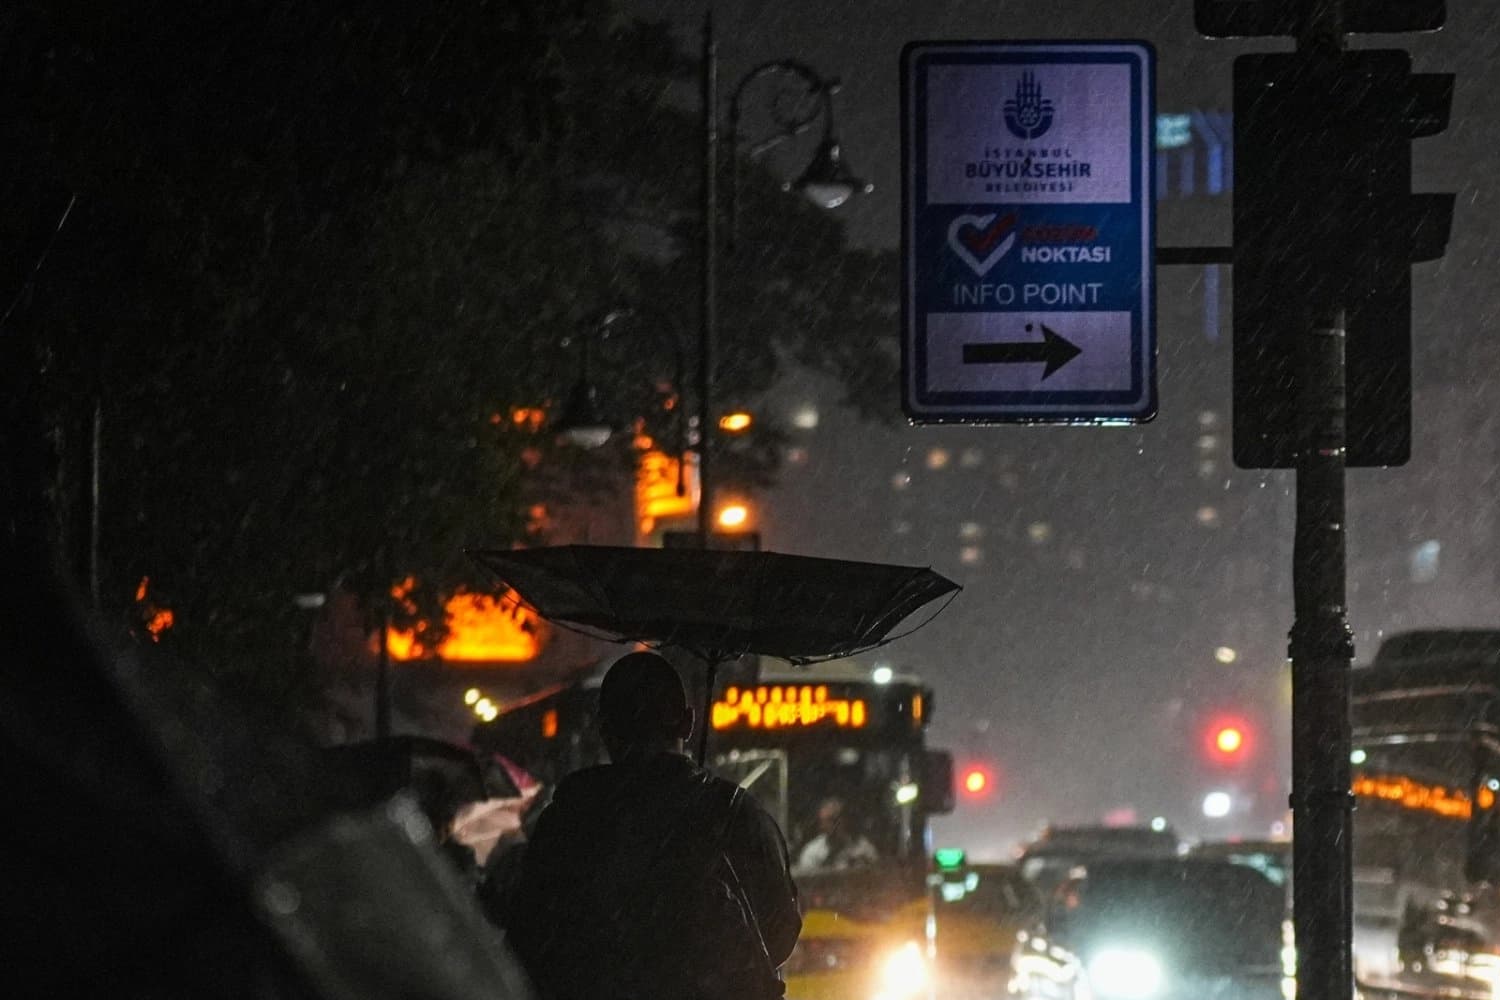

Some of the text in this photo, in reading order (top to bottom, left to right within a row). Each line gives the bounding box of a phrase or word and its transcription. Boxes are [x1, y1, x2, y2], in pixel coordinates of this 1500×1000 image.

[1021, 245, 1111, 263] NOKTASI
[953, 282, 1104, 305] INFO POINT
